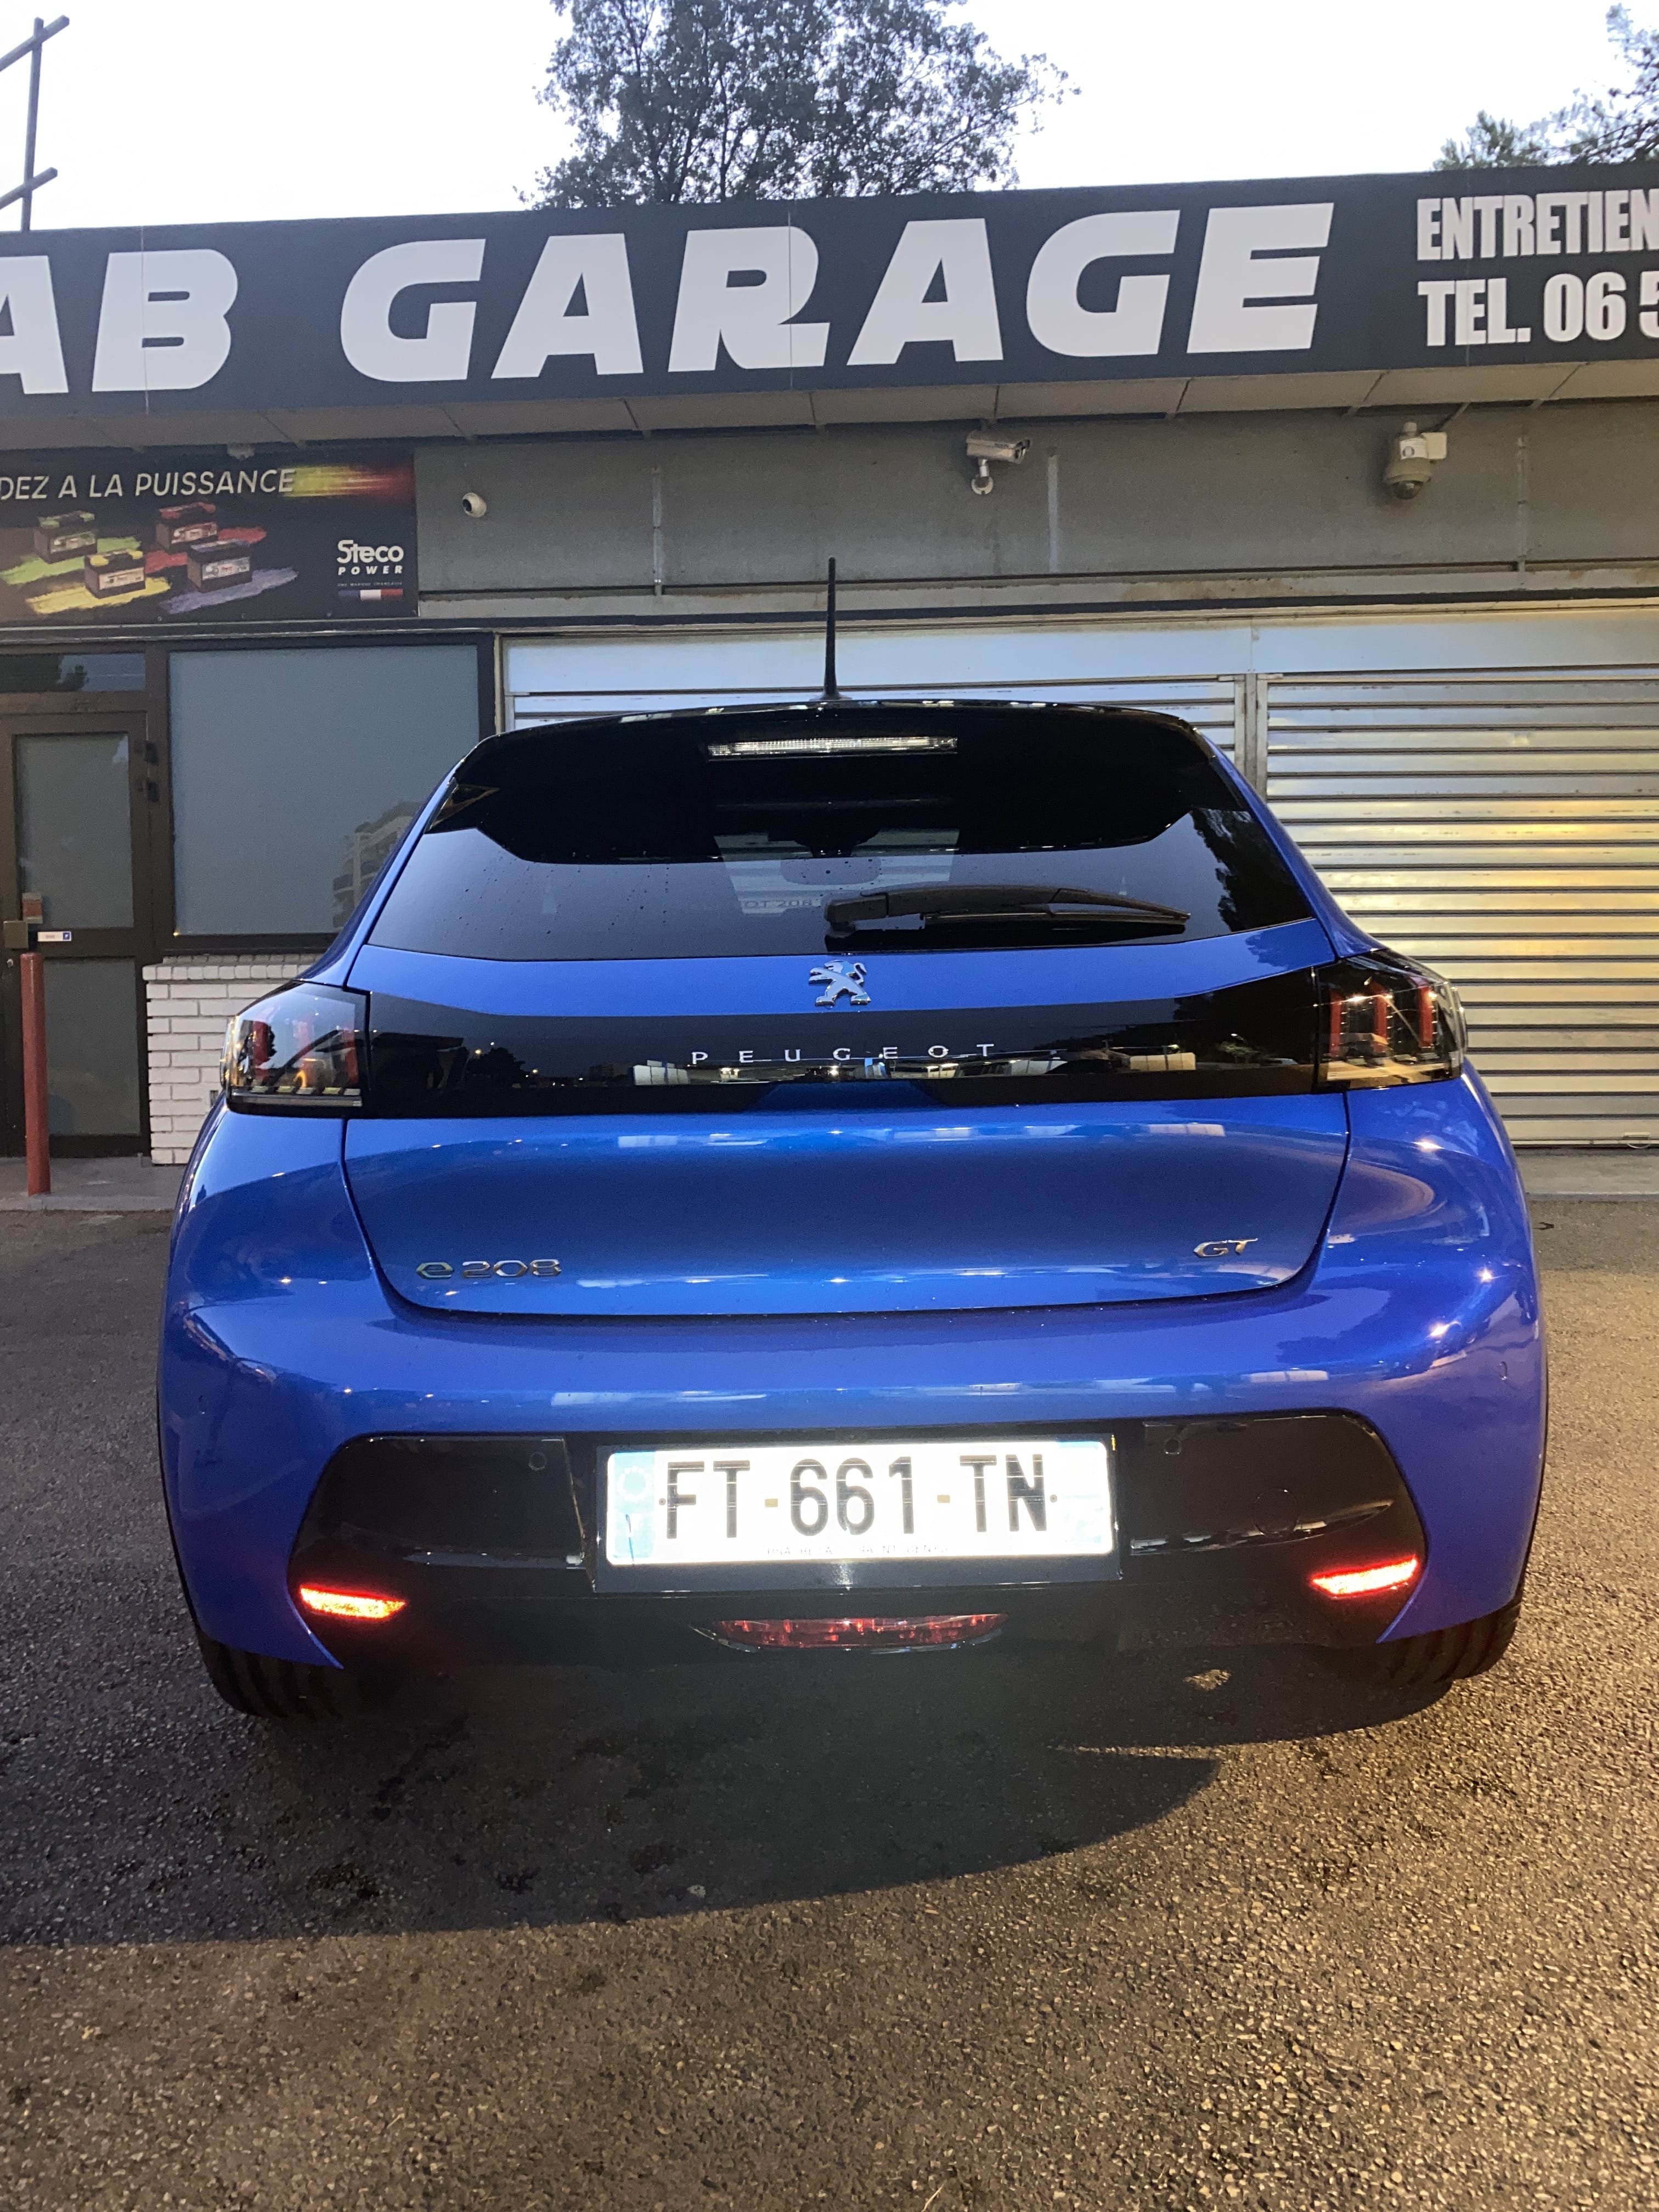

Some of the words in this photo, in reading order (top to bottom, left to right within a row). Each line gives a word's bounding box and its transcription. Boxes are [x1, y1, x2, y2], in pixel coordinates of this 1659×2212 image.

[1417, 189, 1659, 261] ENTRETIEN
[340, 202, 1334, 382] GARAGE
[1418, 278, 1531, 346] TEL.
[1544, 272, 1627, 342] 06
[0, 476, 49, 500] DEZ
[58, 475, 77, 498] A
[89, 474, 122, 497] LA
[136, 469, 295, 496] PUISSANCE
[337, 540, 404, 563] Steco
[338, 565, 403, 575] POWER
[692, 1043, 995, 1065] PEUGEOT
[1193, 1238, 1258, 1257] GT
